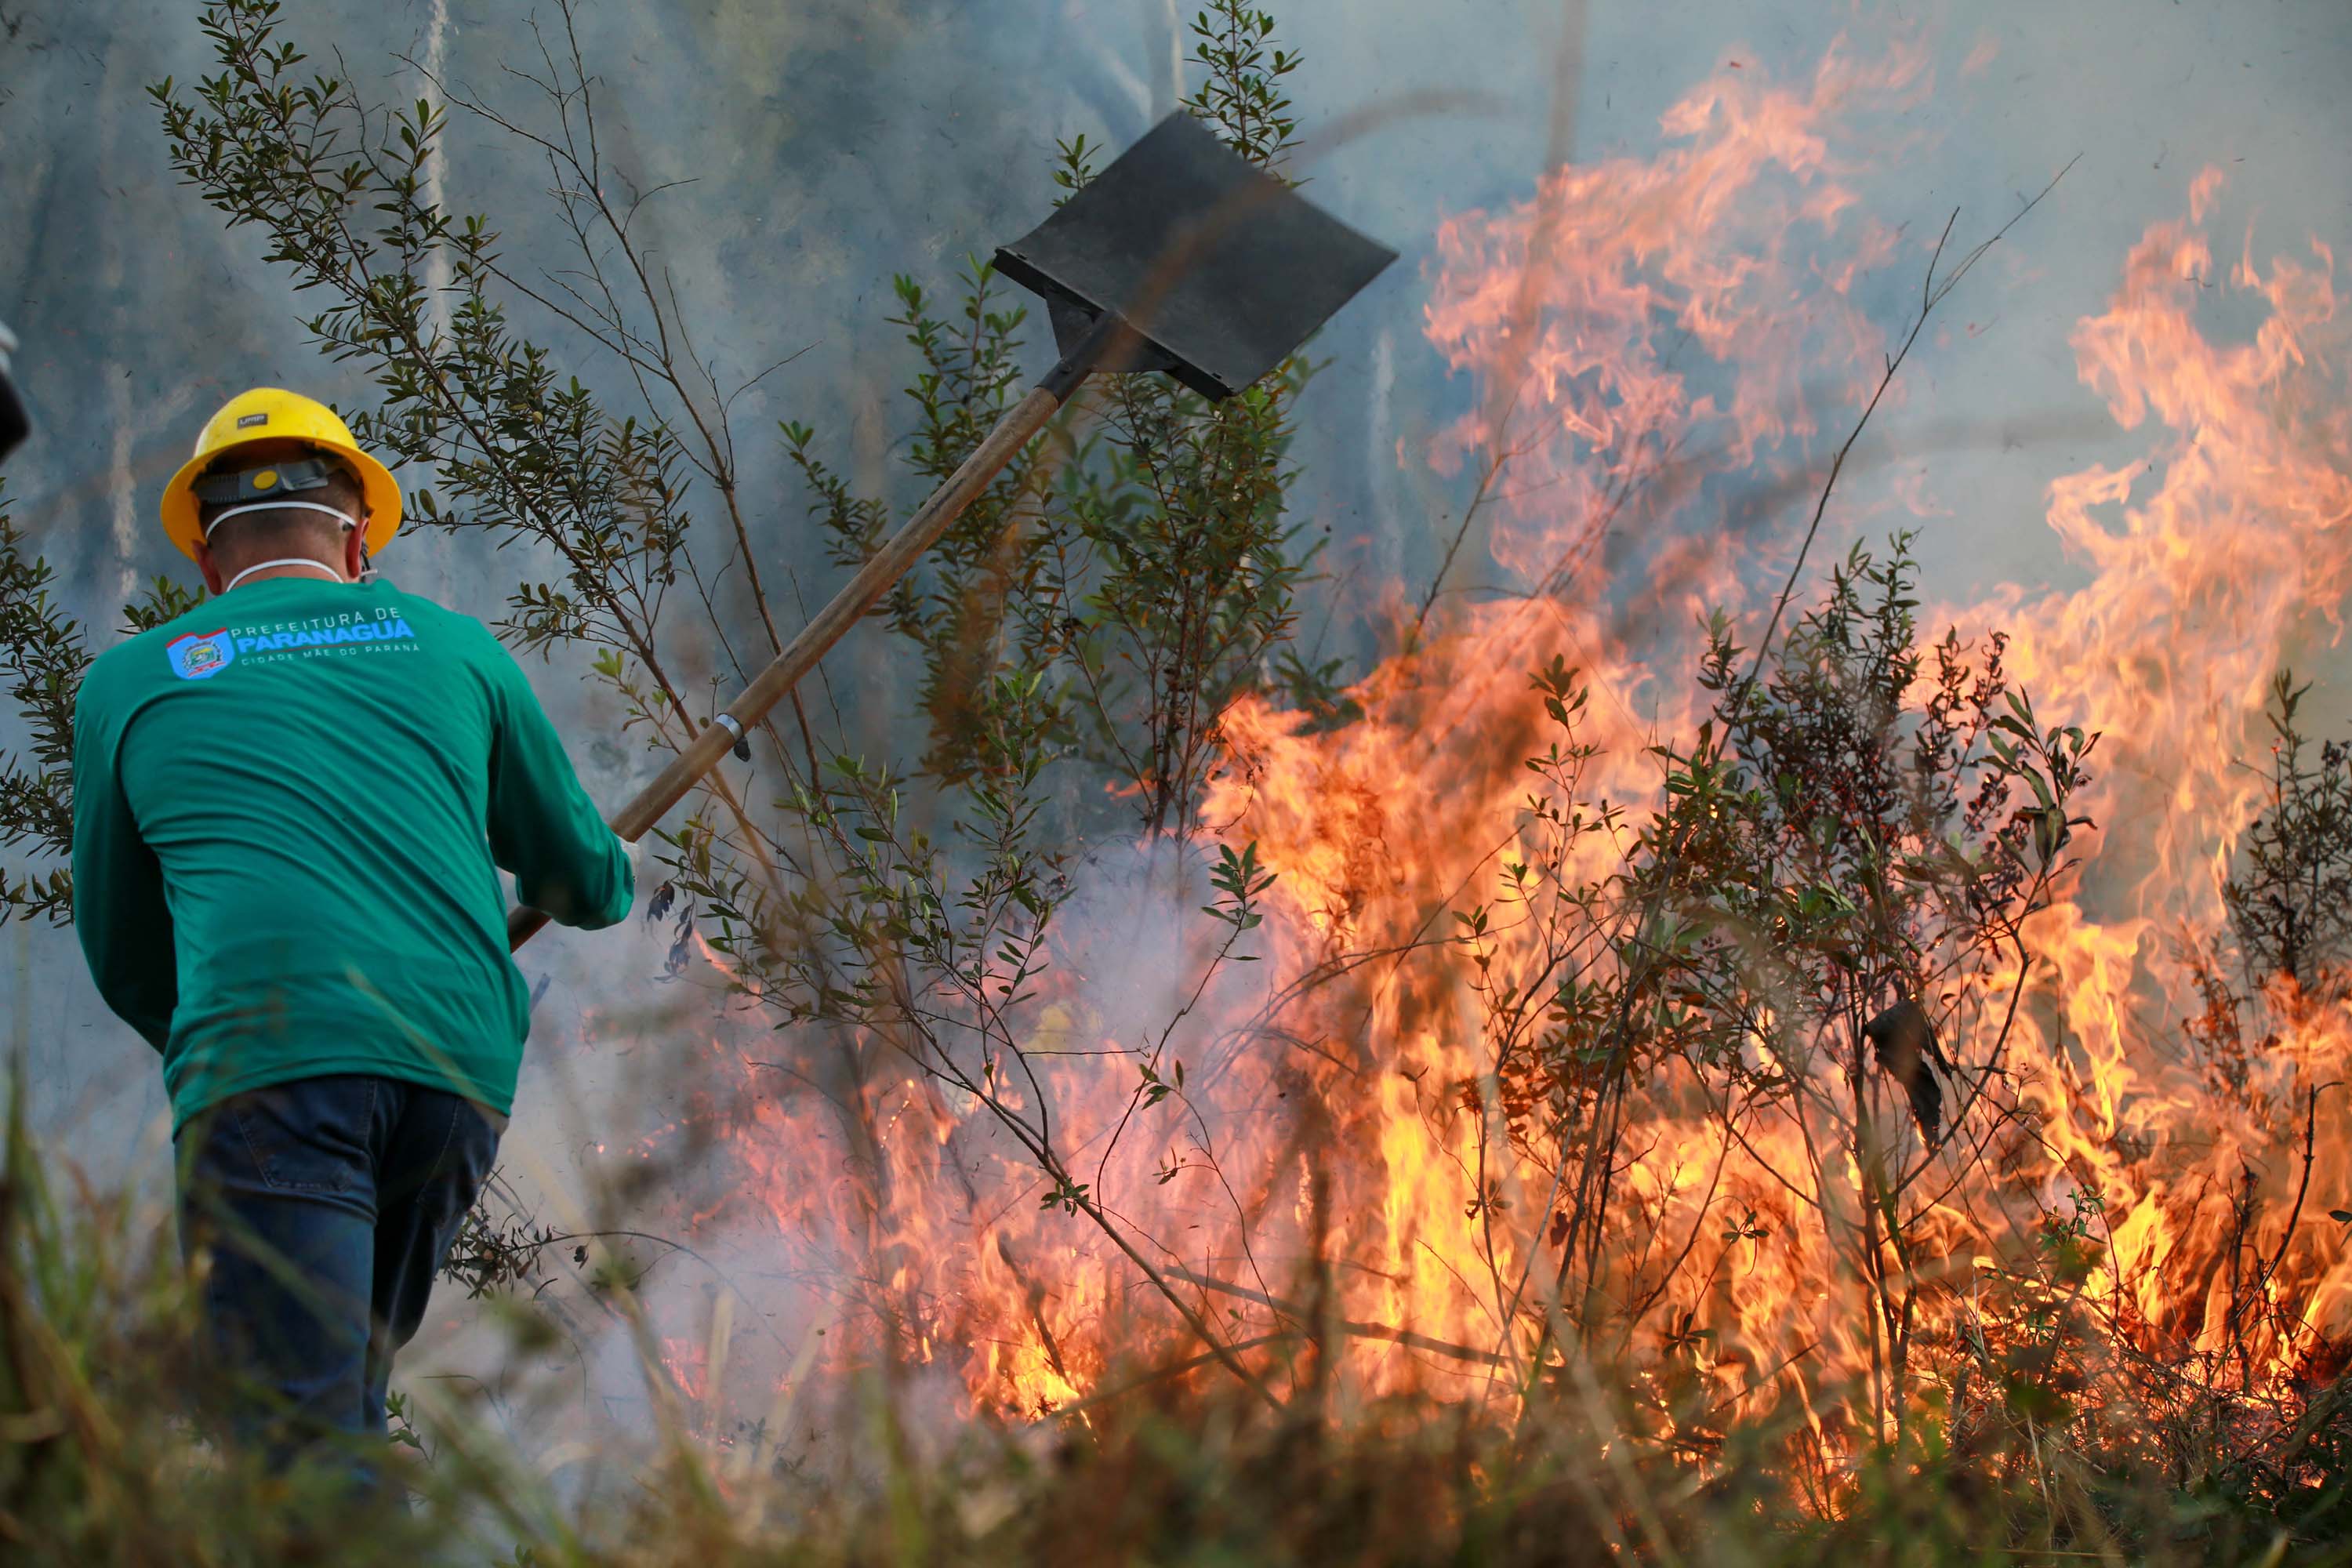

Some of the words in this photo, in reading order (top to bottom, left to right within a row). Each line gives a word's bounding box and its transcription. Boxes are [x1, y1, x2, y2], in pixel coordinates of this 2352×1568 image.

[230, 611, 365, 638] PREFEITURA
[376, 607, 401, 620] DE
[241, 654, 295, 666] CIDADE
[339, 648, 357, 656] DO
